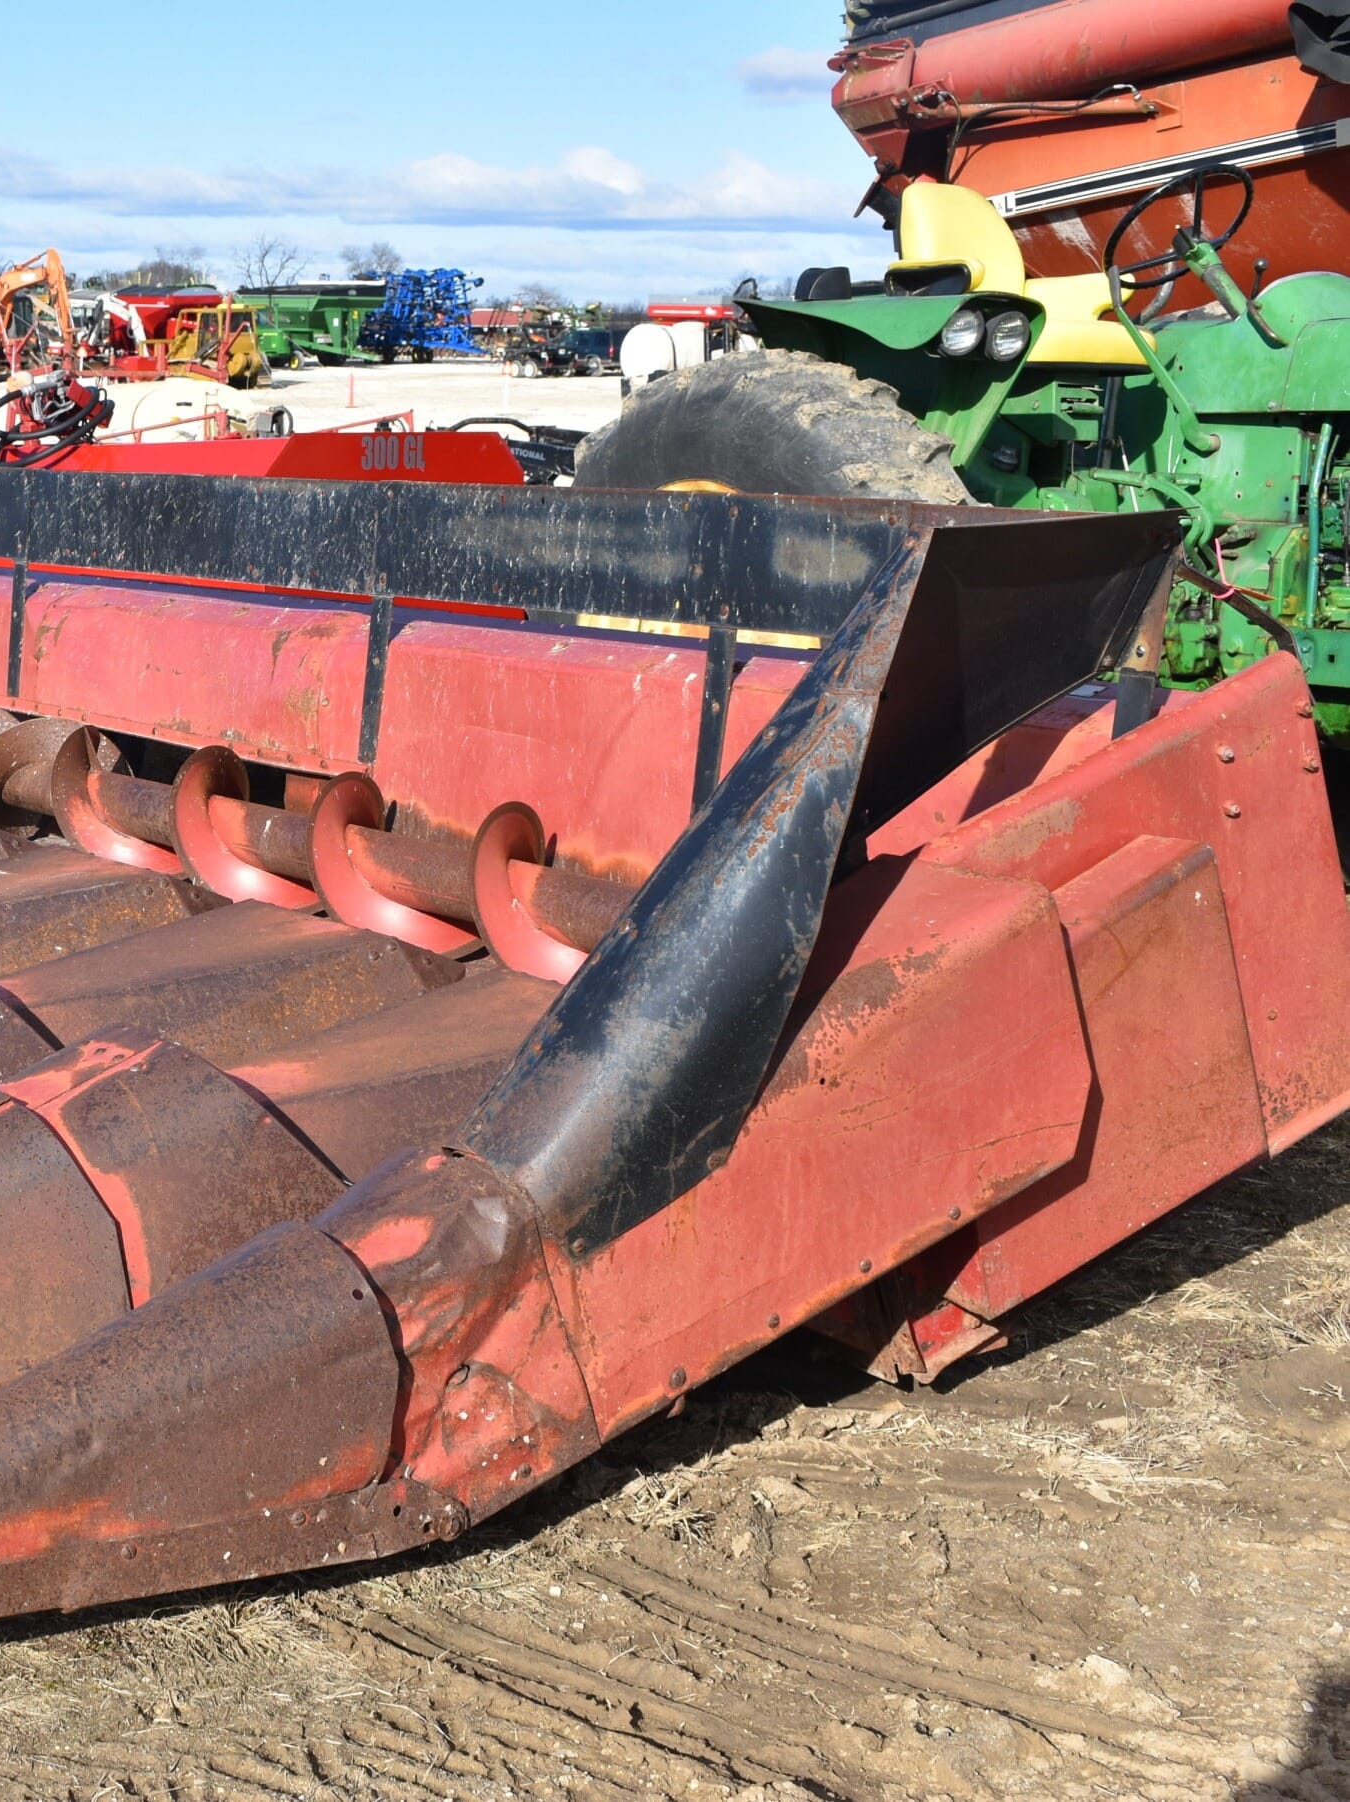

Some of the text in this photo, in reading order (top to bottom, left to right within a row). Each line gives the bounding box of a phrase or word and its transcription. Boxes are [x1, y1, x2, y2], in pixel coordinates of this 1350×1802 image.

[1004, 195, 1013, 213] L
[361, 434, 425, 470] 300 GL
